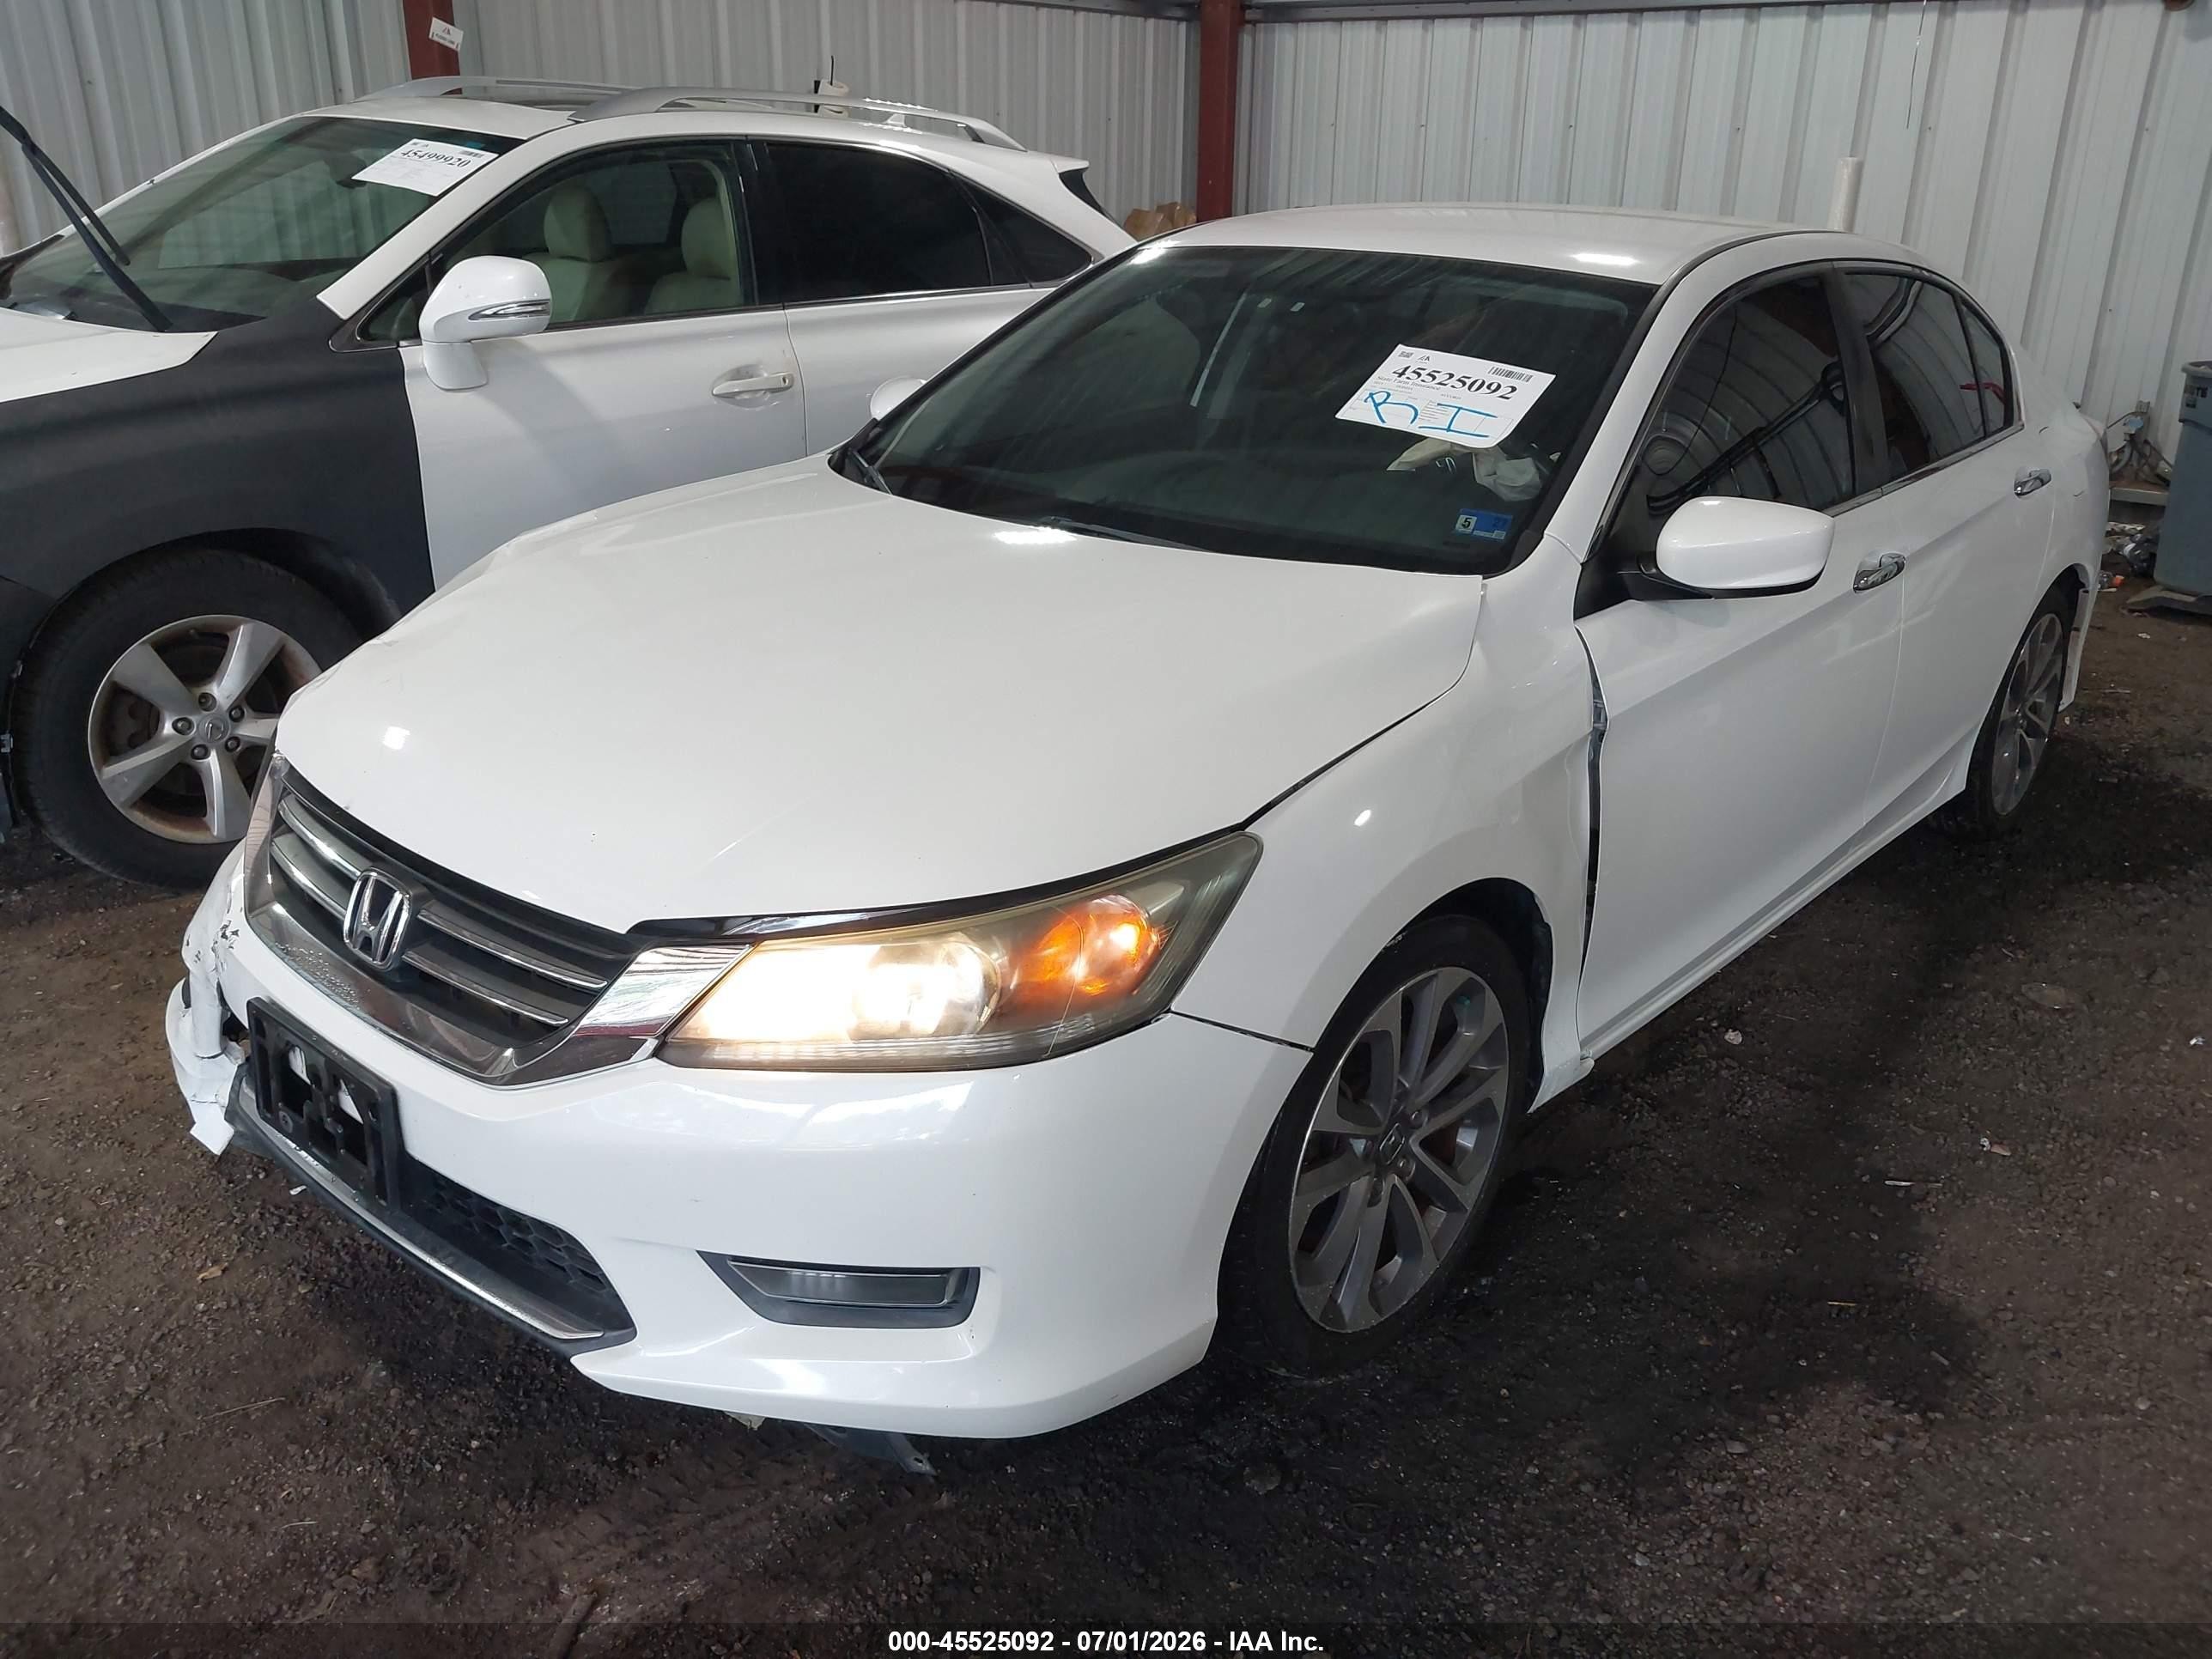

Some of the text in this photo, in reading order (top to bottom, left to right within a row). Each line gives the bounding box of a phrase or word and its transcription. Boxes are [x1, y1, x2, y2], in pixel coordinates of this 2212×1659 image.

[401, 149, 471, 167] 45499920
[1392, 365, 1517, 400] 45525092
[1462, 517, 1473, 529] 5
